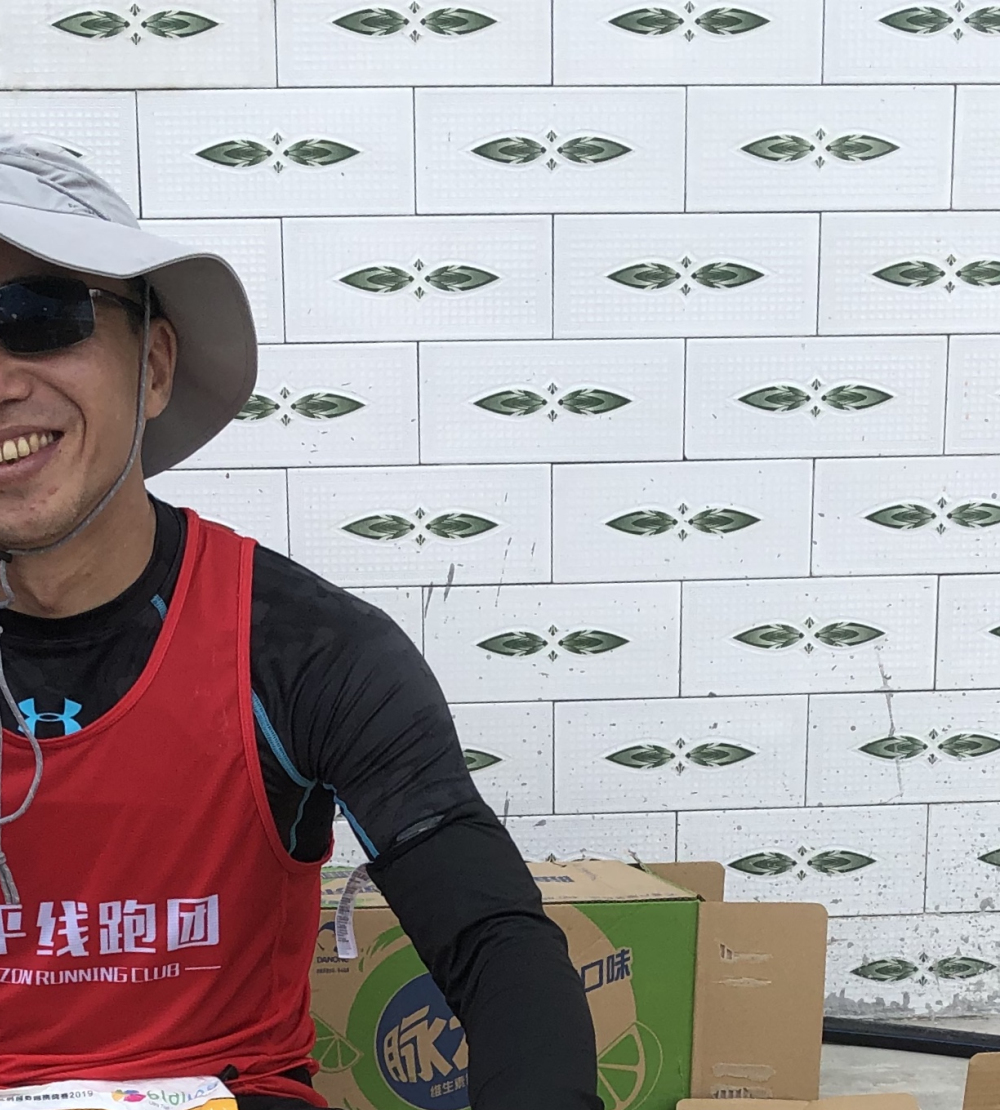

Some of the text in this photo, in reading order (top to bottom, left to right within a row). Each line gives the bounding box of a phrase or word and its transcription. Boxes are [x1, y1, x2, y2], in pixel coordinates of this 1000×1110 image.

[35, 965, 128, 986] RUNNING
[131, 962, 181, 984] CLUB
[580, 948, 631, 993] 口味
